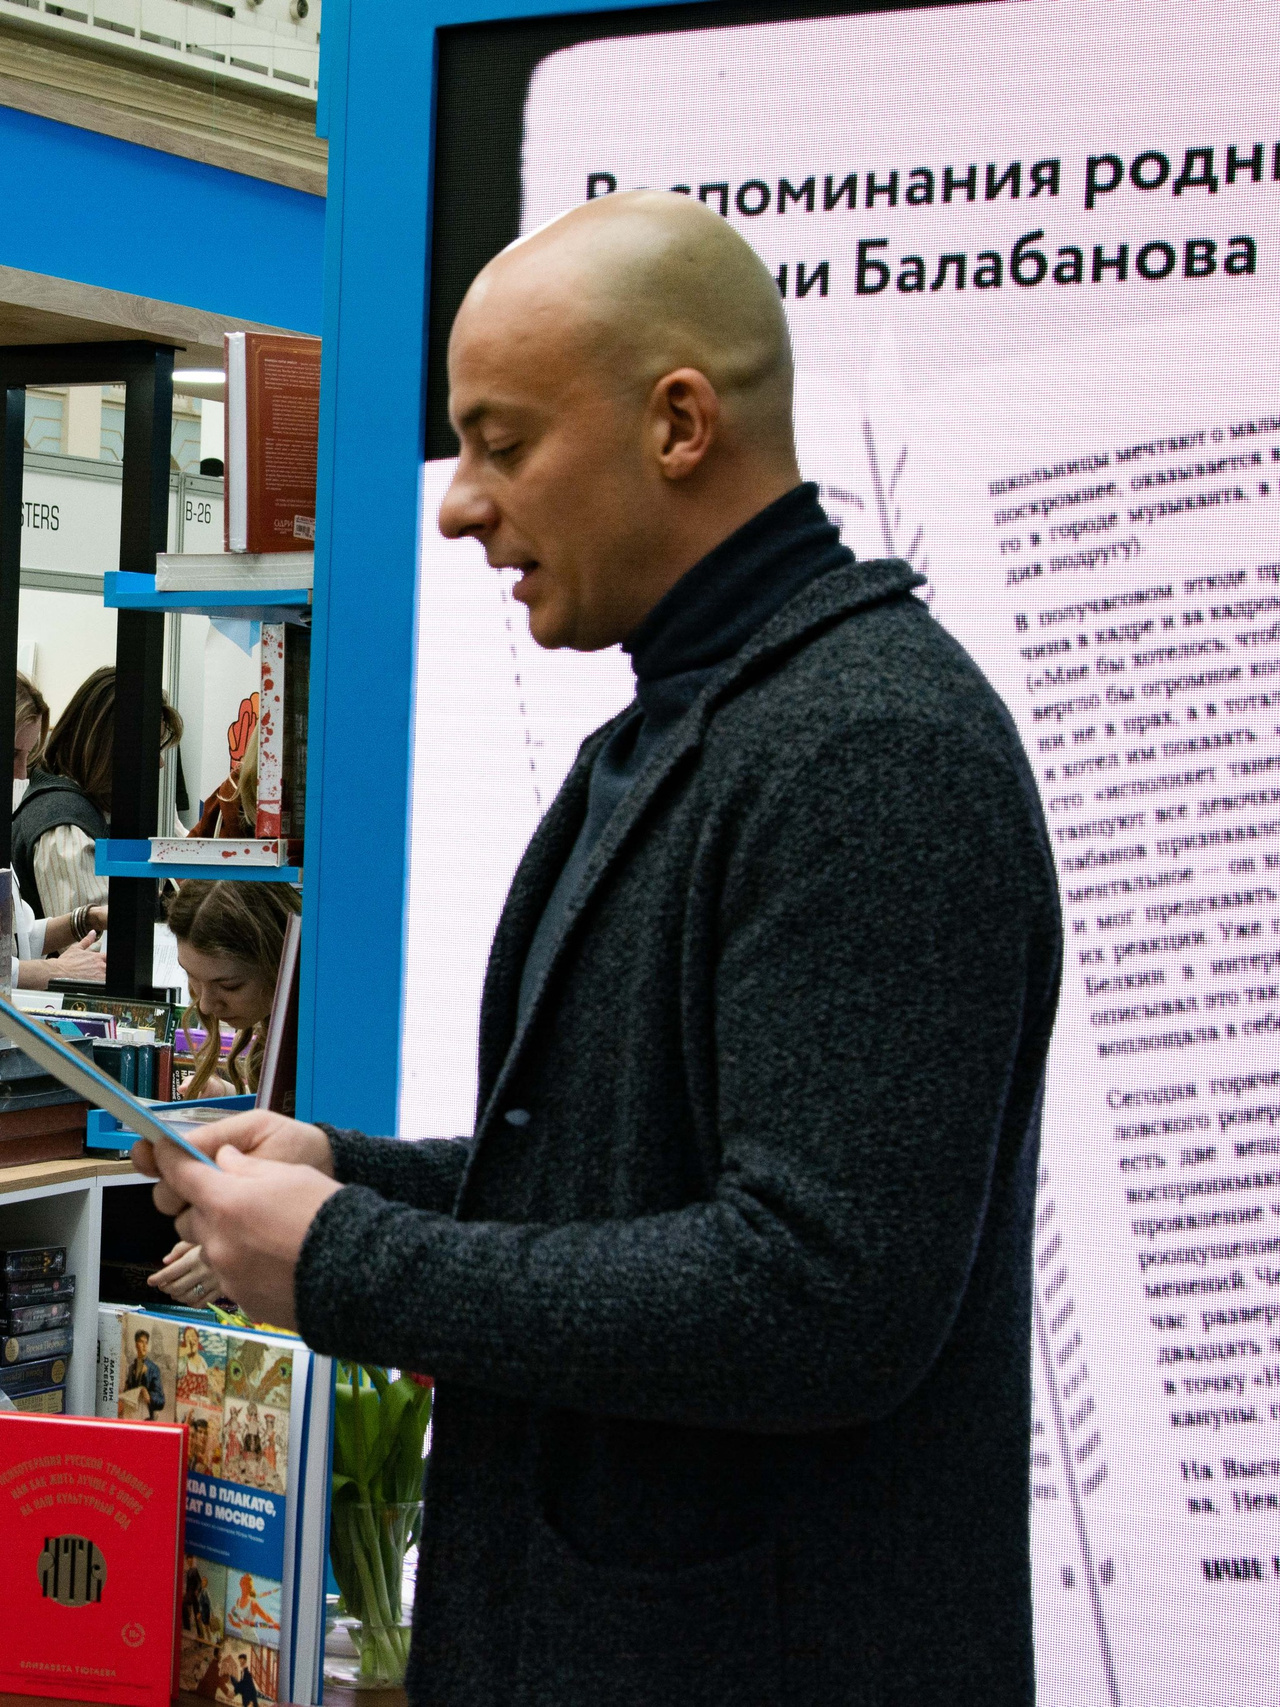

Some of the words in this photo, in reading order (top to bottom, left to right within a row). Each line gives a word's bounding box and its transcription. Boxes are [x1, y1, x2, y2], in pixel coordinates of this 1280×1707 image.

[586, 156, 1062, 222] Впоминания
[854, 228, 1257, 298] Балабанова
[989, 451, 1109, 497] школьницы
[1116, 431, 1205, 463] мечтают
[1211, 427, 1223, 443] о
[1131, 451, 1261, 491] оказывается
[1000, 537, 1021, 555] го
[1050, 513, 1118, 542] городе
[1039, 584, 1173, 626] получасовом
[1184, 568, 1247, 595] этюде
[1020, 640, 1071, 662] чина
[1095, 619, 1154, 646] кадре
[1162, 614, 1175, 630] и
[1182, 606, 1203, 625] за
[1096, 655, 1125, 674] бы
[1033, 696, 1101, 723] вергло
[1106, 684, 1135, 705] бы
[1142, 667, 1242, 699] огромное
[1073, 726, 1096, 745] не
[1063, 752, 1120, 780] хотел
[1126, 743, 1156, 763] им
[1049, 792, 1084, 813] сто
[1055, 813, 1146, 843] танцуют
[1155, 804, 1188, 823] все
[1062, 845, 1147, 874] лабанов
[1067, 866, 1194, 904] ментальное
[1228, 857, 1256, 874] он
[1073, 918, 1087, 935] и
[1097, 909, 1136, 931] мог
[1145, 886, 1278, 926] предсказать
[1078, 948, 1106, 966] их
[1218, 919, 1263, 942] Уже
[1084, 968, 1166, 998] Белкин
[1090, 995, 1200, 1028] описывал
[1205, 990, 1240, 1011] это
[1097, 1024, 1219, 1060] воплощала
[1106, 1081, 1198, 1110] Сегодня
[1119, 1152, 1167, 1173] есть
[1180, 1145, 1217, 1168] две
[1131, 1205, 1264, 1241] проявление
[1149, 1312, 1188, 1332] час
[1157, 1336, 1262, 1367] двадцать
[1184, 1373, 1246, 1399] точку
[64, 1454, 104, 1470] РУССКОЙ
[1179, 1458, 1214, 1482] На
[28, 1475, 47, 1491] КАК
[49, 1473, 74, 1485] ЖИТЬ
[209, 1484, 218, 1499] В
[55, 1492, 115, 1516] КУЛЬТУРНЫЙ
[204, 1502, 213, 1517] В
[19, 1660, 73, 1674] ЕЛИЗАВЕТА
